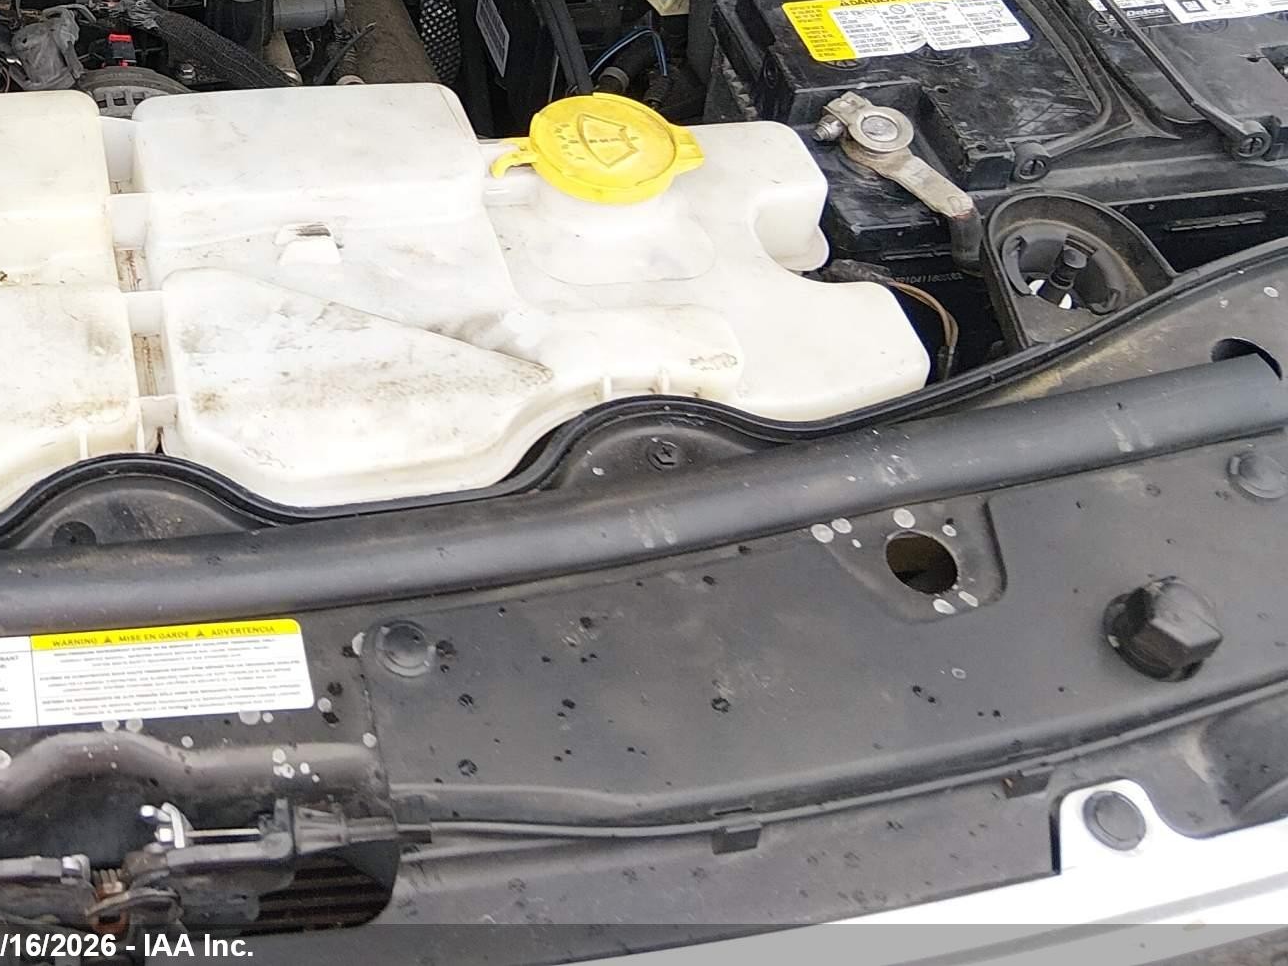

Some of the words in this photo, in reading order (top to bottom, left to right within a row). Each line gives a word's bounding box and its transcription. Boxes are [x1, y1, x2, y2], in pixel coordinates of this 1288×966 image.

[52, 636, 97, 648] WARNING
[118, 634, 142, 643] MISE
[144, 633, 157, 641] EN
[158, 631, 190, 640] GARDE
[211, 625, 275, 637] ADVERTENCIA
